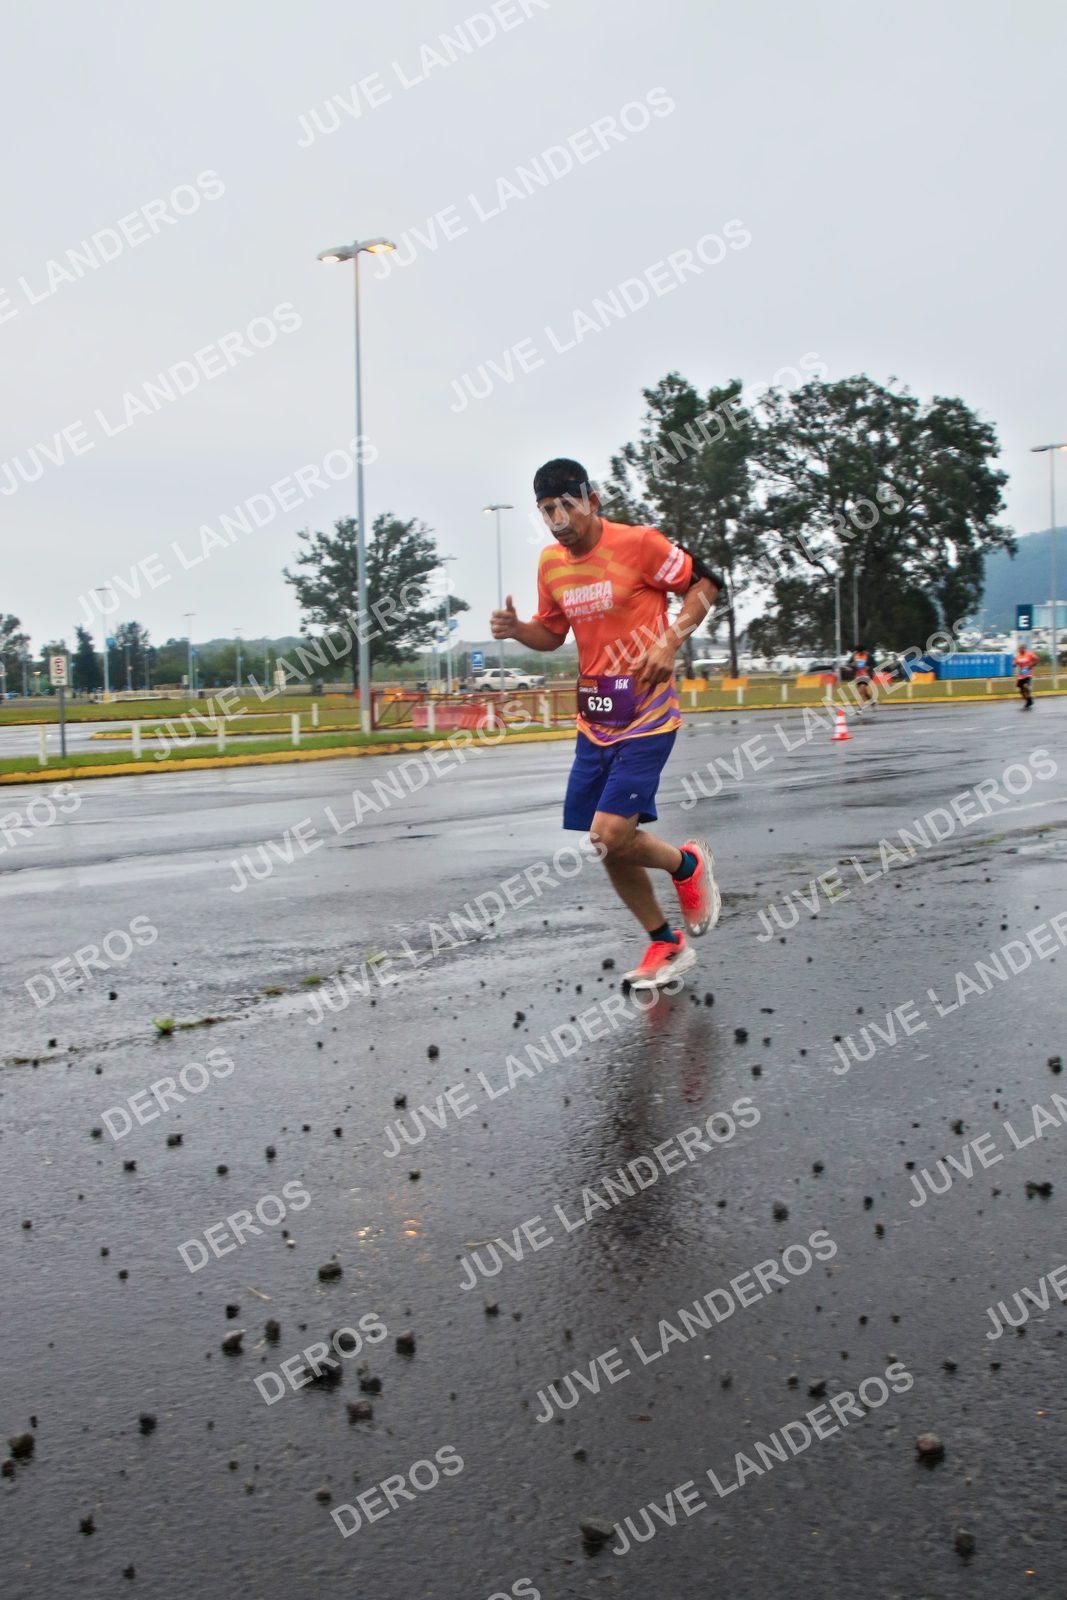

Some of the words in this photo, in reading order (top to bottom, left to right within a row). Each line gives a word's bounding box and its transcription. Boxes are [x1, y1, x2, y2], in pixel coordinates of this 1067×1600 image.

[563, 580, 612, 606] CARRERA
[1018, 615, 1030, 627] E
[588, 697, 613, 712] 629
